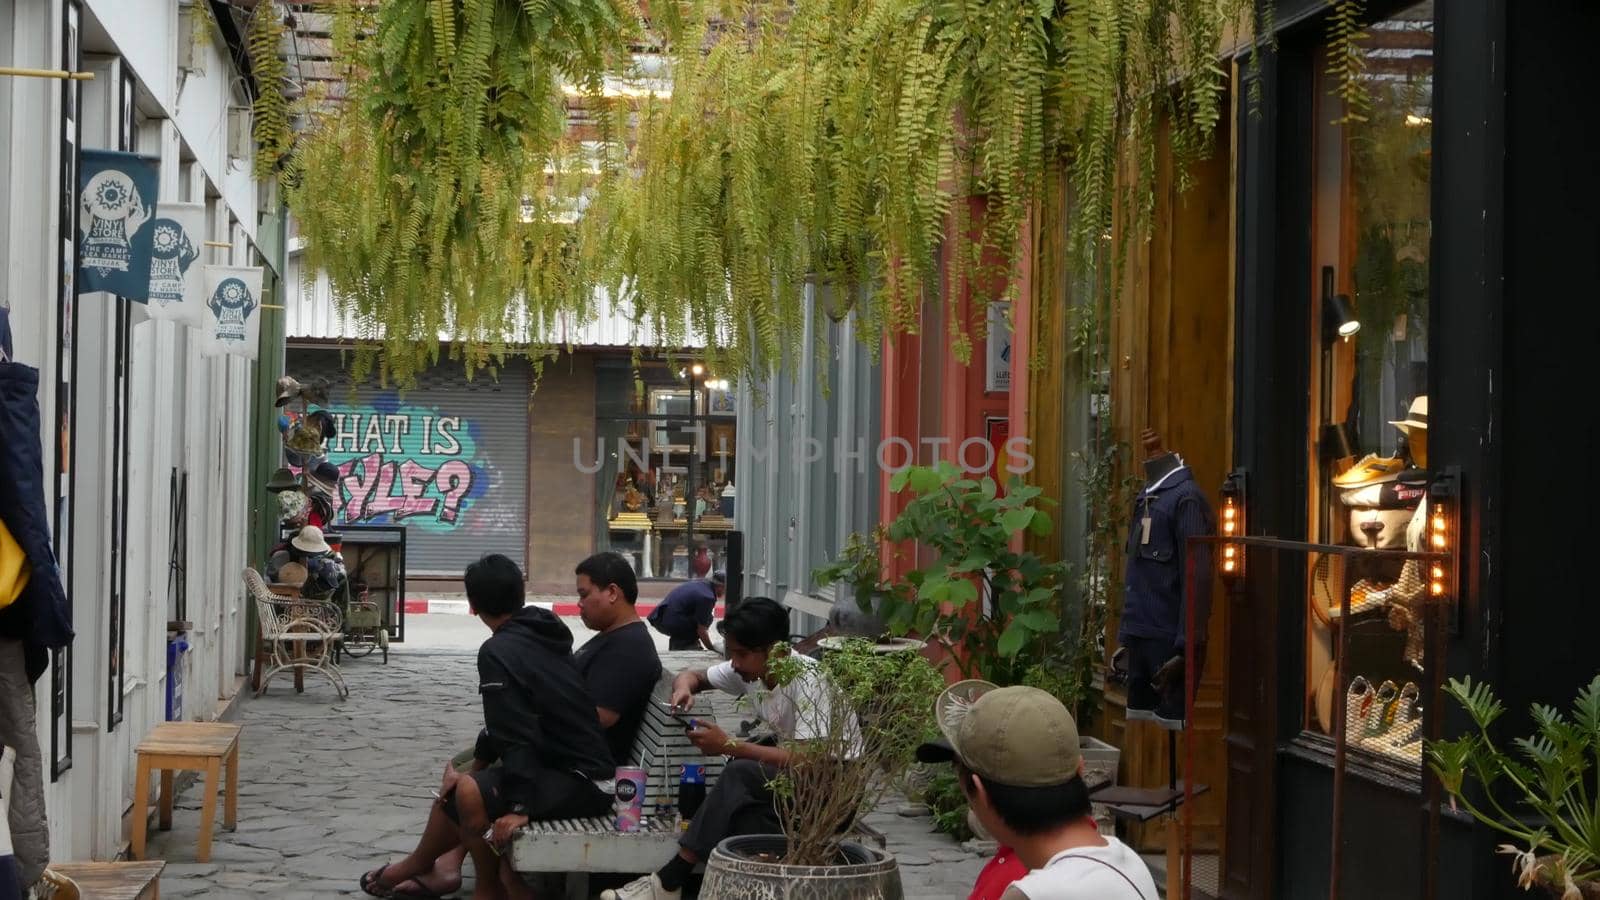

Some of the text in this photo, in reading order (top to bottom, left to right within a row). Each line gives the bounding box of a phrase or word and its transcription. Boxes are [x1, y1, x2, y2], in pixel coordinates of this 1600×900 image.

[93, 218, 124, 229] VINYL
[92, 227, 124, 239] STORE
[104, 246, 128, 254] CAMP
[420, 415, 462, 454] IS
